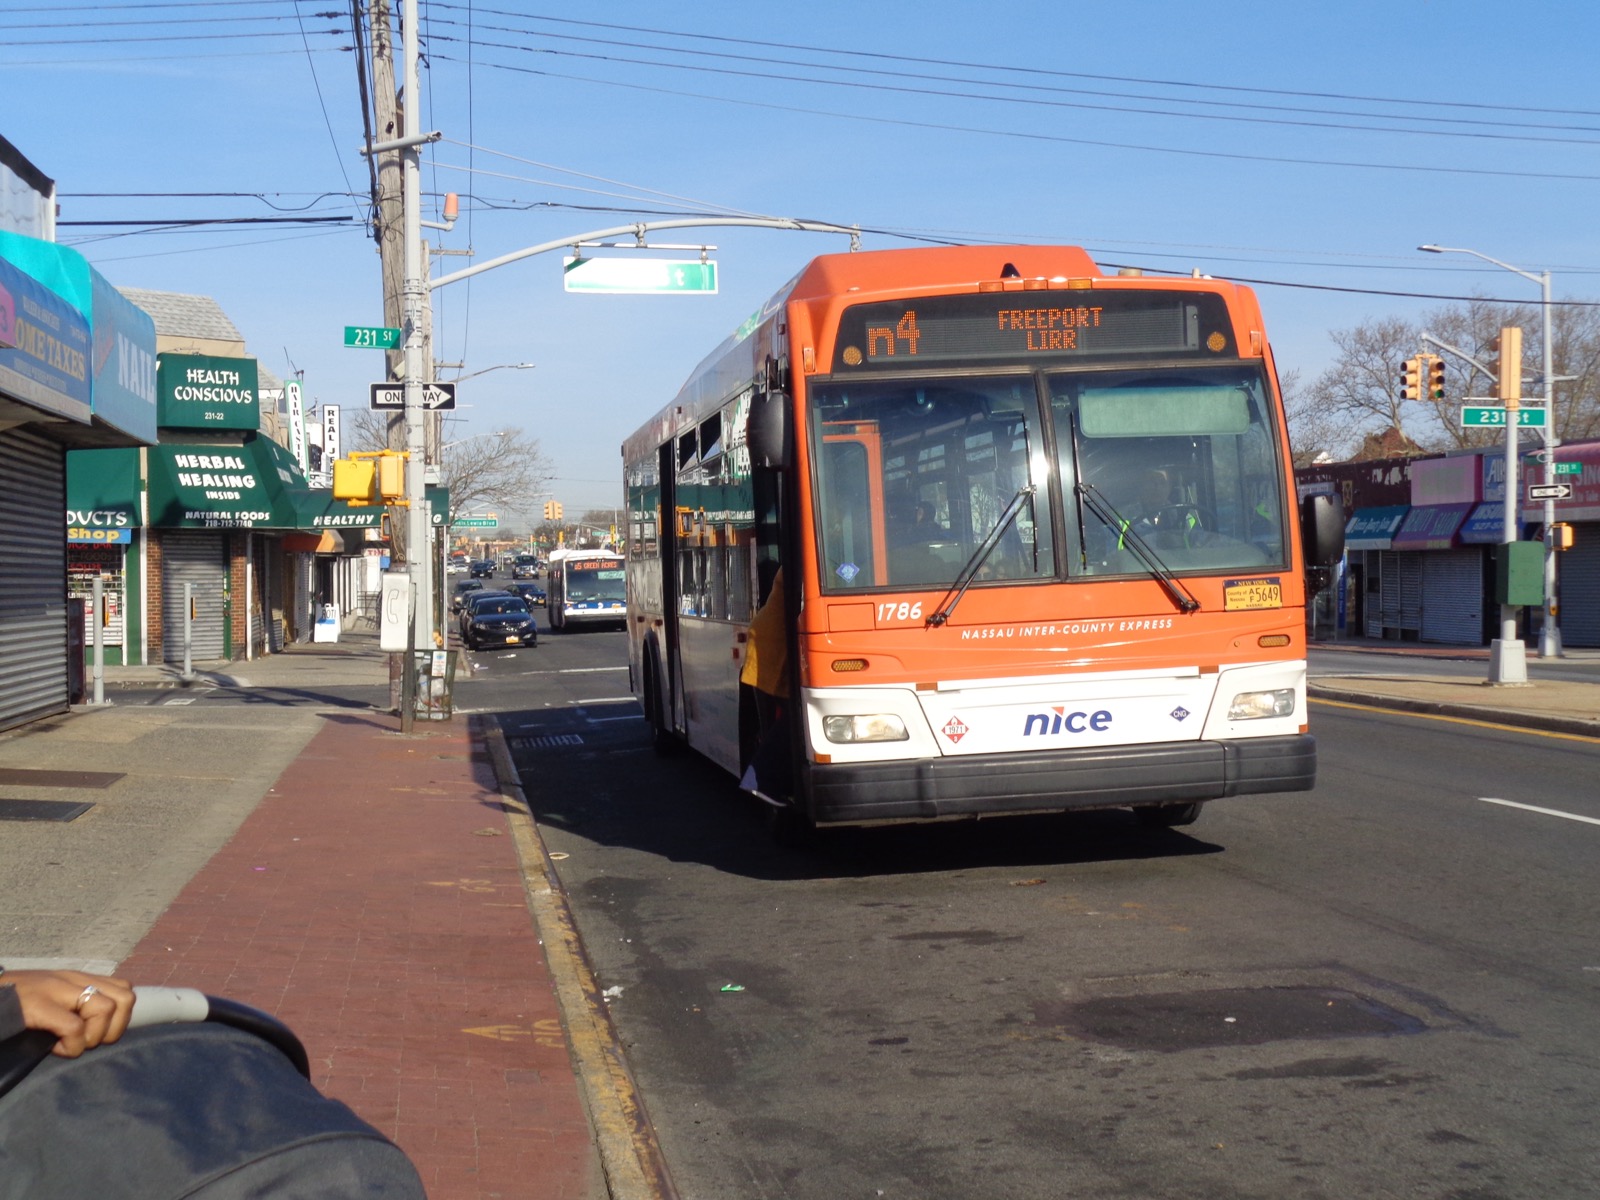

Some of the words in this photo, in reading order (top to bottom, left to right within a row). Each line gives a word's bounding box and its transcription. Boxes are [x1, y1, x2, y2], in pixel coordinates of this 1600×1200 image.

[998, 307, 1102, 330] FREEPORT
[354, 328, 377, 346] 231
[383, 331, 392, 341] St
[868, 310, 920, 356] n4
[1027, 330, 1076, 350] LIRR
[47, 335, 85, 381] TAXES
[186, 368, 239, 386] HEALTH
[174, 386, 252, 404] CONSCIOUS
[204, 412, 224, 420] 231-22
[1480, 411, 1506, 423] 231
[327, 409, 336, 441] REAL
[174, 454, 245, 470] HERBAL
[1558, 464, 1569, 473] 231
[178, 473, 256, 488] HEALING
[205, 490, 240, 500] INSIDE
[185, 511, 232, 520] NATURAL
[235, 511, 270, 521] FOODS
[313, 514, 375, 526] HEALTHY
[68, 527, 120, 543] Shop
[1255, 586, 1279, 603] 5649
[877, 601, 922, 622] 1786
[961, 628, 1013, 640] NASSAU
[1018, 622, 1115, 637] INTER-COUNTY
[1119, 619, 1173, 632] EXPRESS
[1023, 706, 1113, 736] nice
[1173, 710, 1188, 718] CNG
[948, 725, 963, 734] 1971
